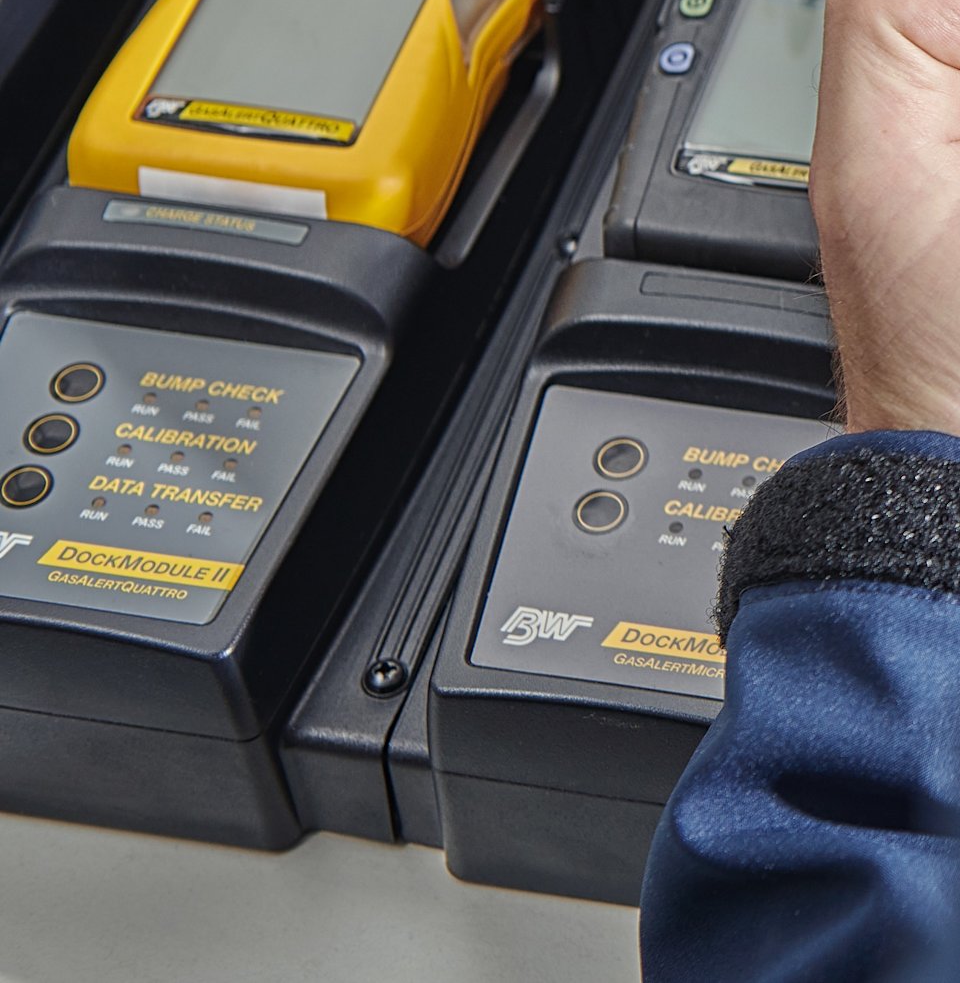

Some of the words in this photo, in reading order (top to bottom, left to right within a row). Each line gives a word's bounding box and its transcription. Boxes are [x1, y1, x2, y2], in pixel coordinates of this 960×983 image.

[140, 371, 205, 393] BUMP
[207, 380, 285, 404] CHECK
[131, 403, 160, 416] RUN
[182, 410, 215, 424] PASS
[235, 417, 261, 430] FAIL
[115, 422, 257, 455] CALIBRATION
[106, 455, 135, 468] RUN
[157, 462, 190, 476] PASS
[211, 469, 236, 482] FAIL
[683, 446, 749, 468] BUMP
[88, 475, 145, 496] DATA
[150, 483, 263, 513] TRANSFER
[678, 479, 706, 493] RUN
[80, 508, 108, 521] RUN
[131, 516, 165, 530] PASS
[186, 523, 212, 536] FAIL
[658, 533, 687, 546] RUN
[501, 606, 594, 645] BW
[621, 627, 724, 656] DOCKMO
[613, 653, 726, 678] GASALERTMICR
